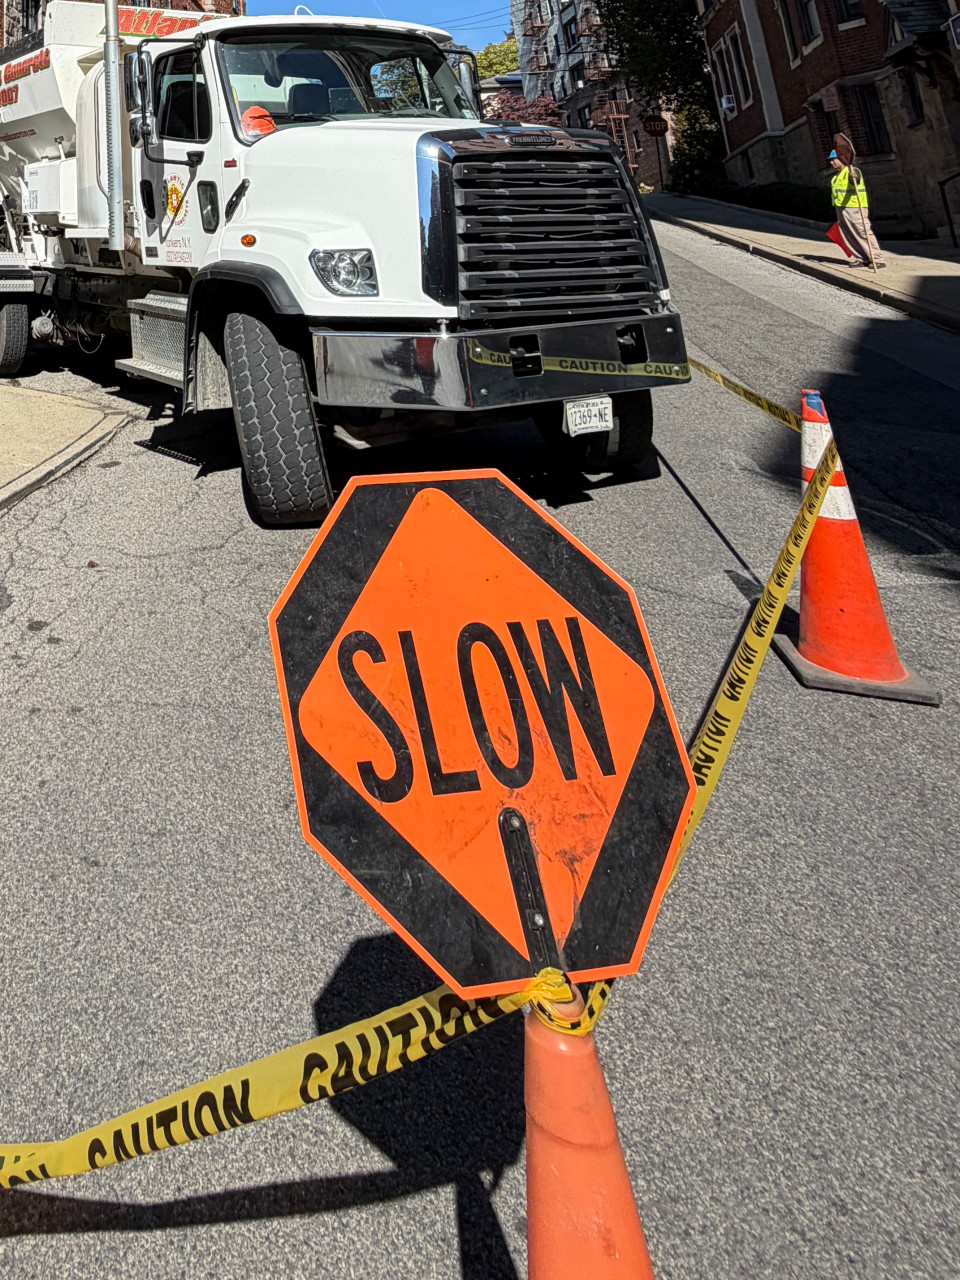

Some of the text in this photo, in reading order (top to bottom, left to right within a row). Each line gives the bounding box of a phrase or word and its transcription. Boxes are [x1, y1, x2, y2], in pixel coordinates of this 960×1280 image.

[645, 121, 667, 130] STOP
[560, 360, 628, 373] CAUTION
[750, 591, 779, 638] CAUTION
[723, 639, 758, 702] CAUTION
[337, 616, 617, 803] SLOW
[87, 1078, 257, 1170] CAUTION
